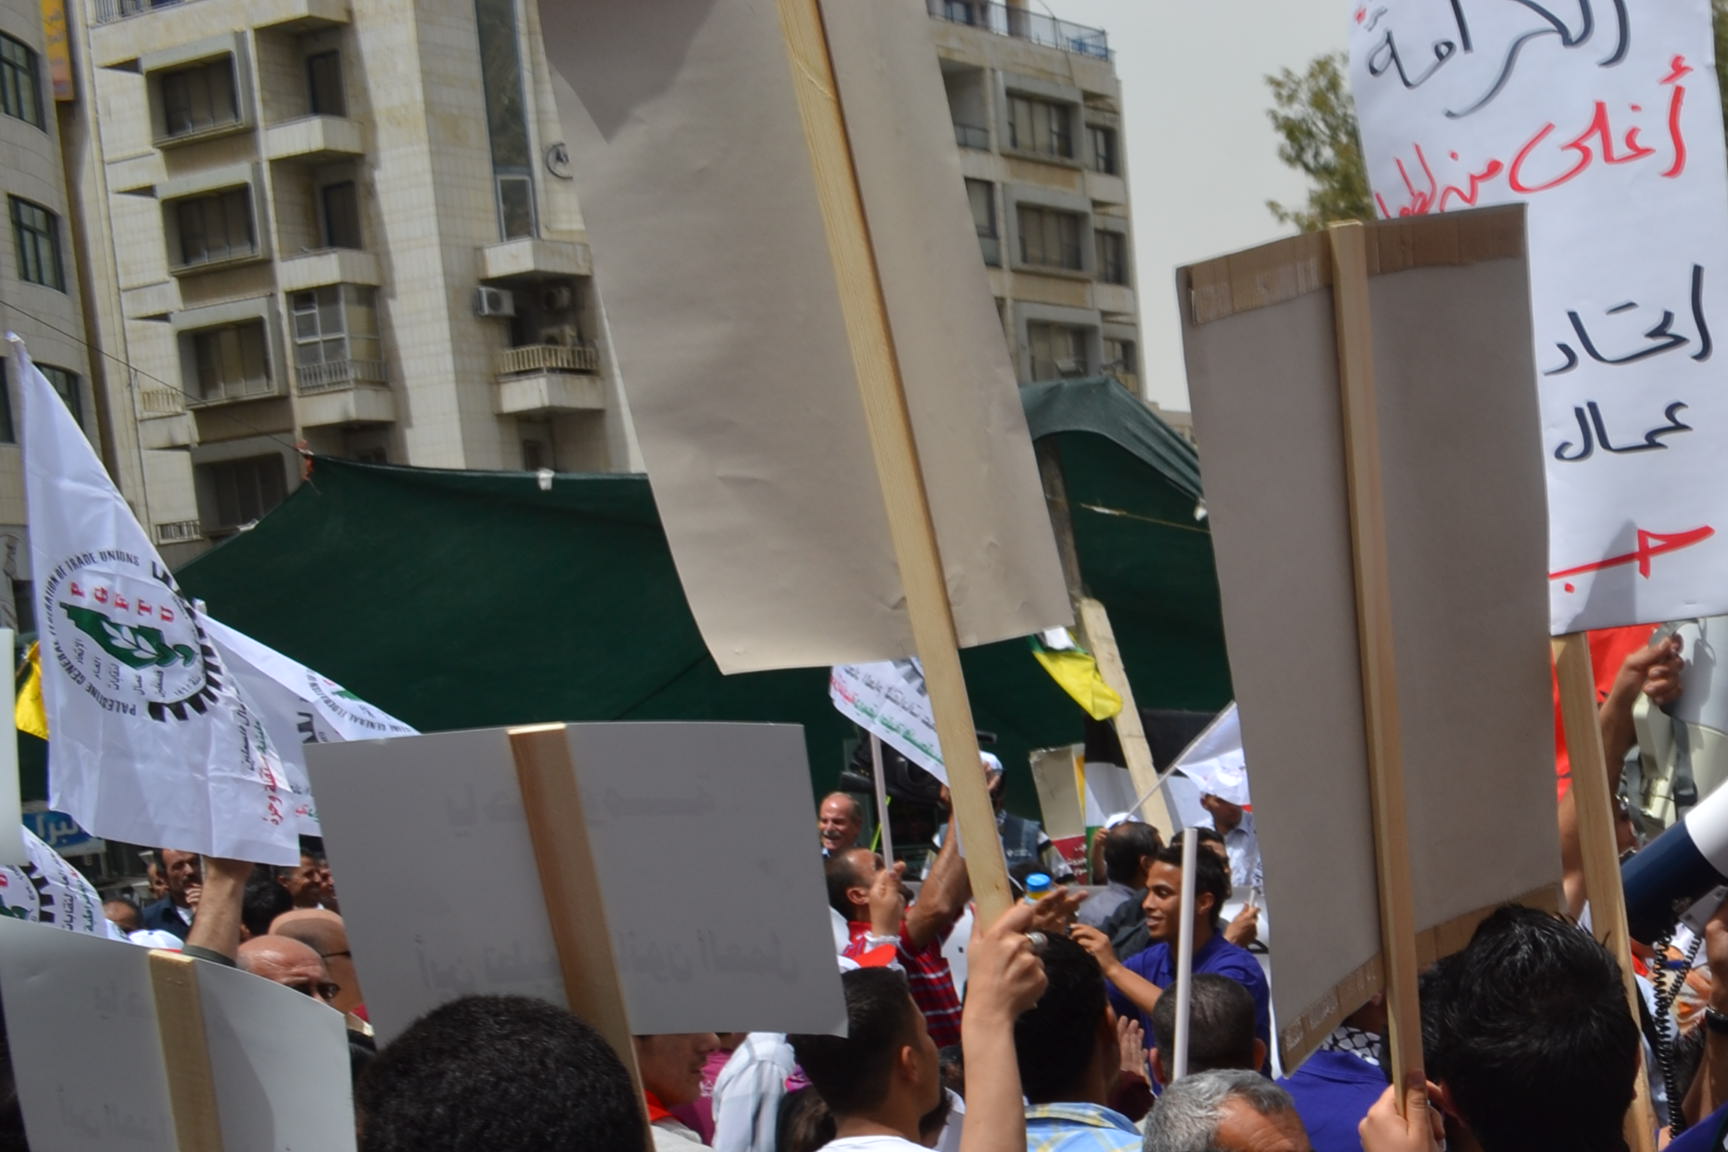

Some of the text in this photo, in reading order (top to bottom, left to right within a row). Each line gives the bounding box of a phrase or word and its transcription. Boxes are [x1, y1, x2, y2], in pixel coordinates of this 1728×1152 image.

[1543, 263, 1714, 376] اتحاد
[1554, 401, 1693, 462] عمال
[98, 549, 141, 568] UNIONS
[85, 683, 137, 716] PALESTINE
